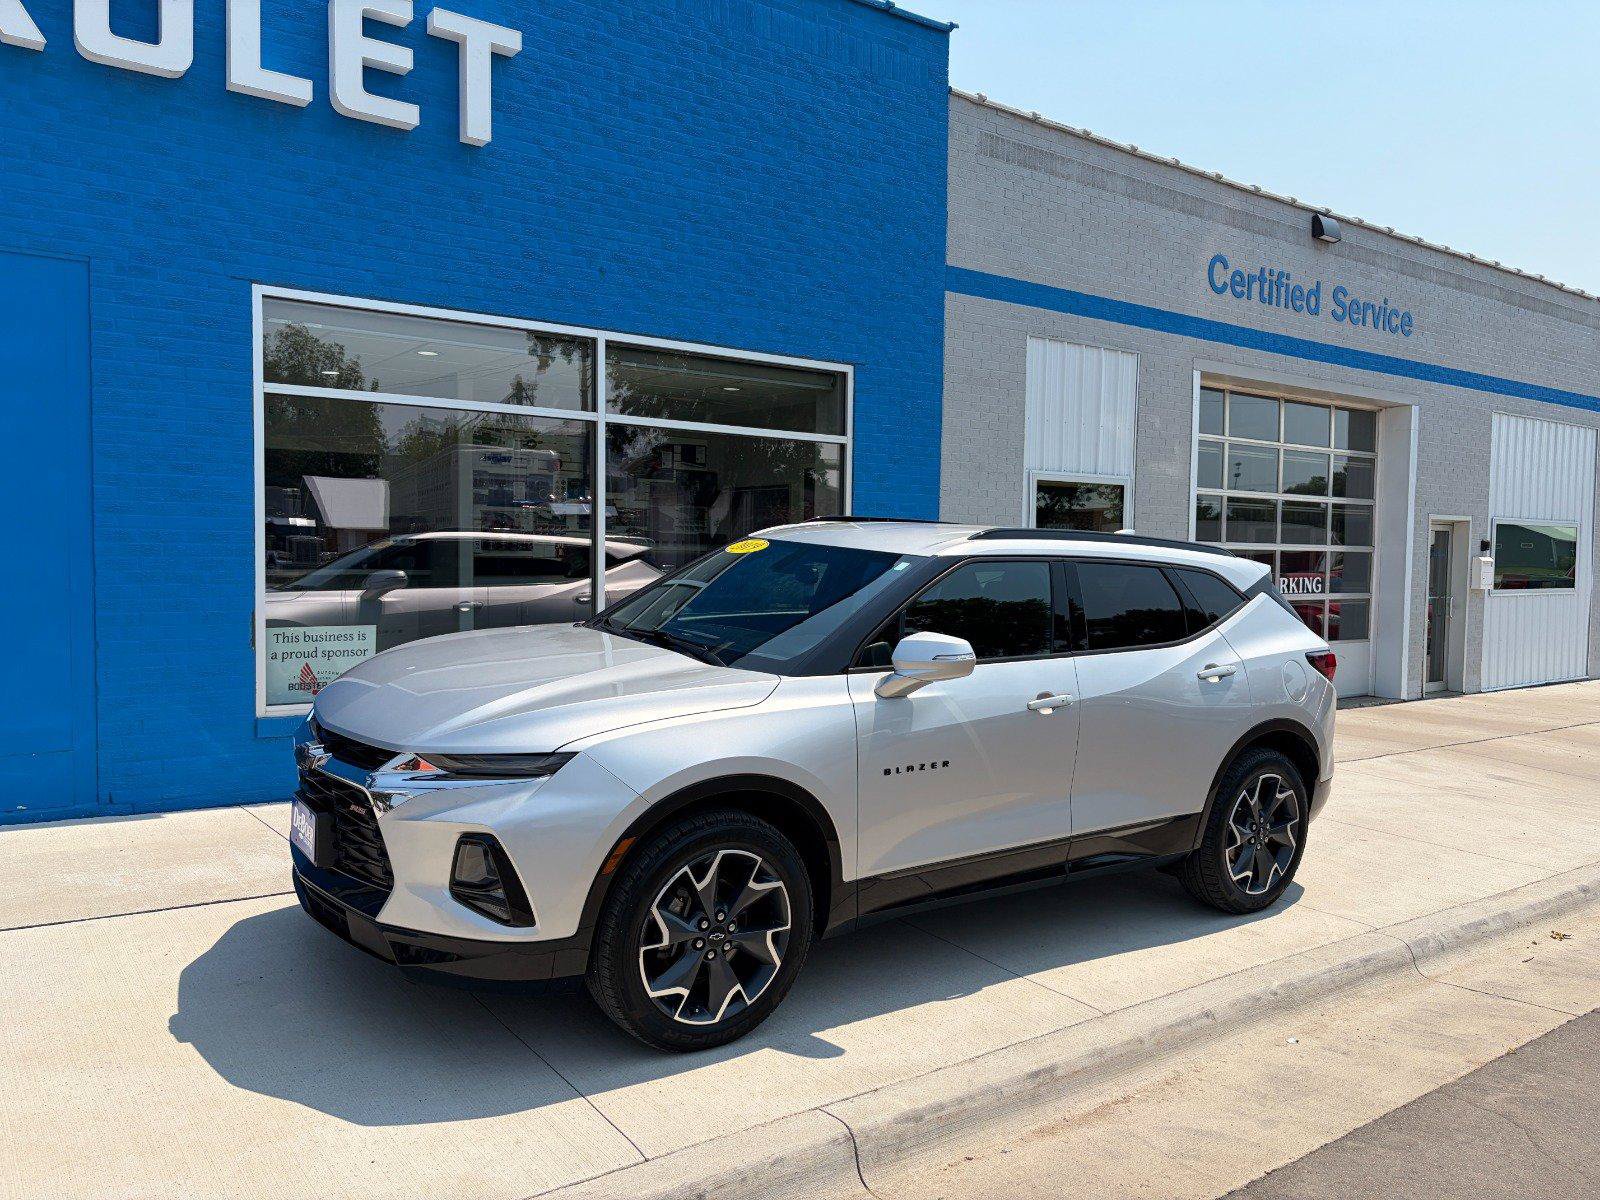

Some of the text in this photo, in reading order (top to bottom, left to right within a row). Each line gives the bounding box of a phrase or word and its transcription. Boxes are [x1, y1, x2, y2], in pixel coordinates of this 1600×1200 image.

[0, 0, 522, 147] OLET
[1208, 254, 1414, 337] Certified Service
[1280, 577, 1322, 594] RKING
[273, 630, 367, 644] This business is
[270, 647, 369, 662] a proud sponsor
[883, 760, 950, 776] BLAZER
